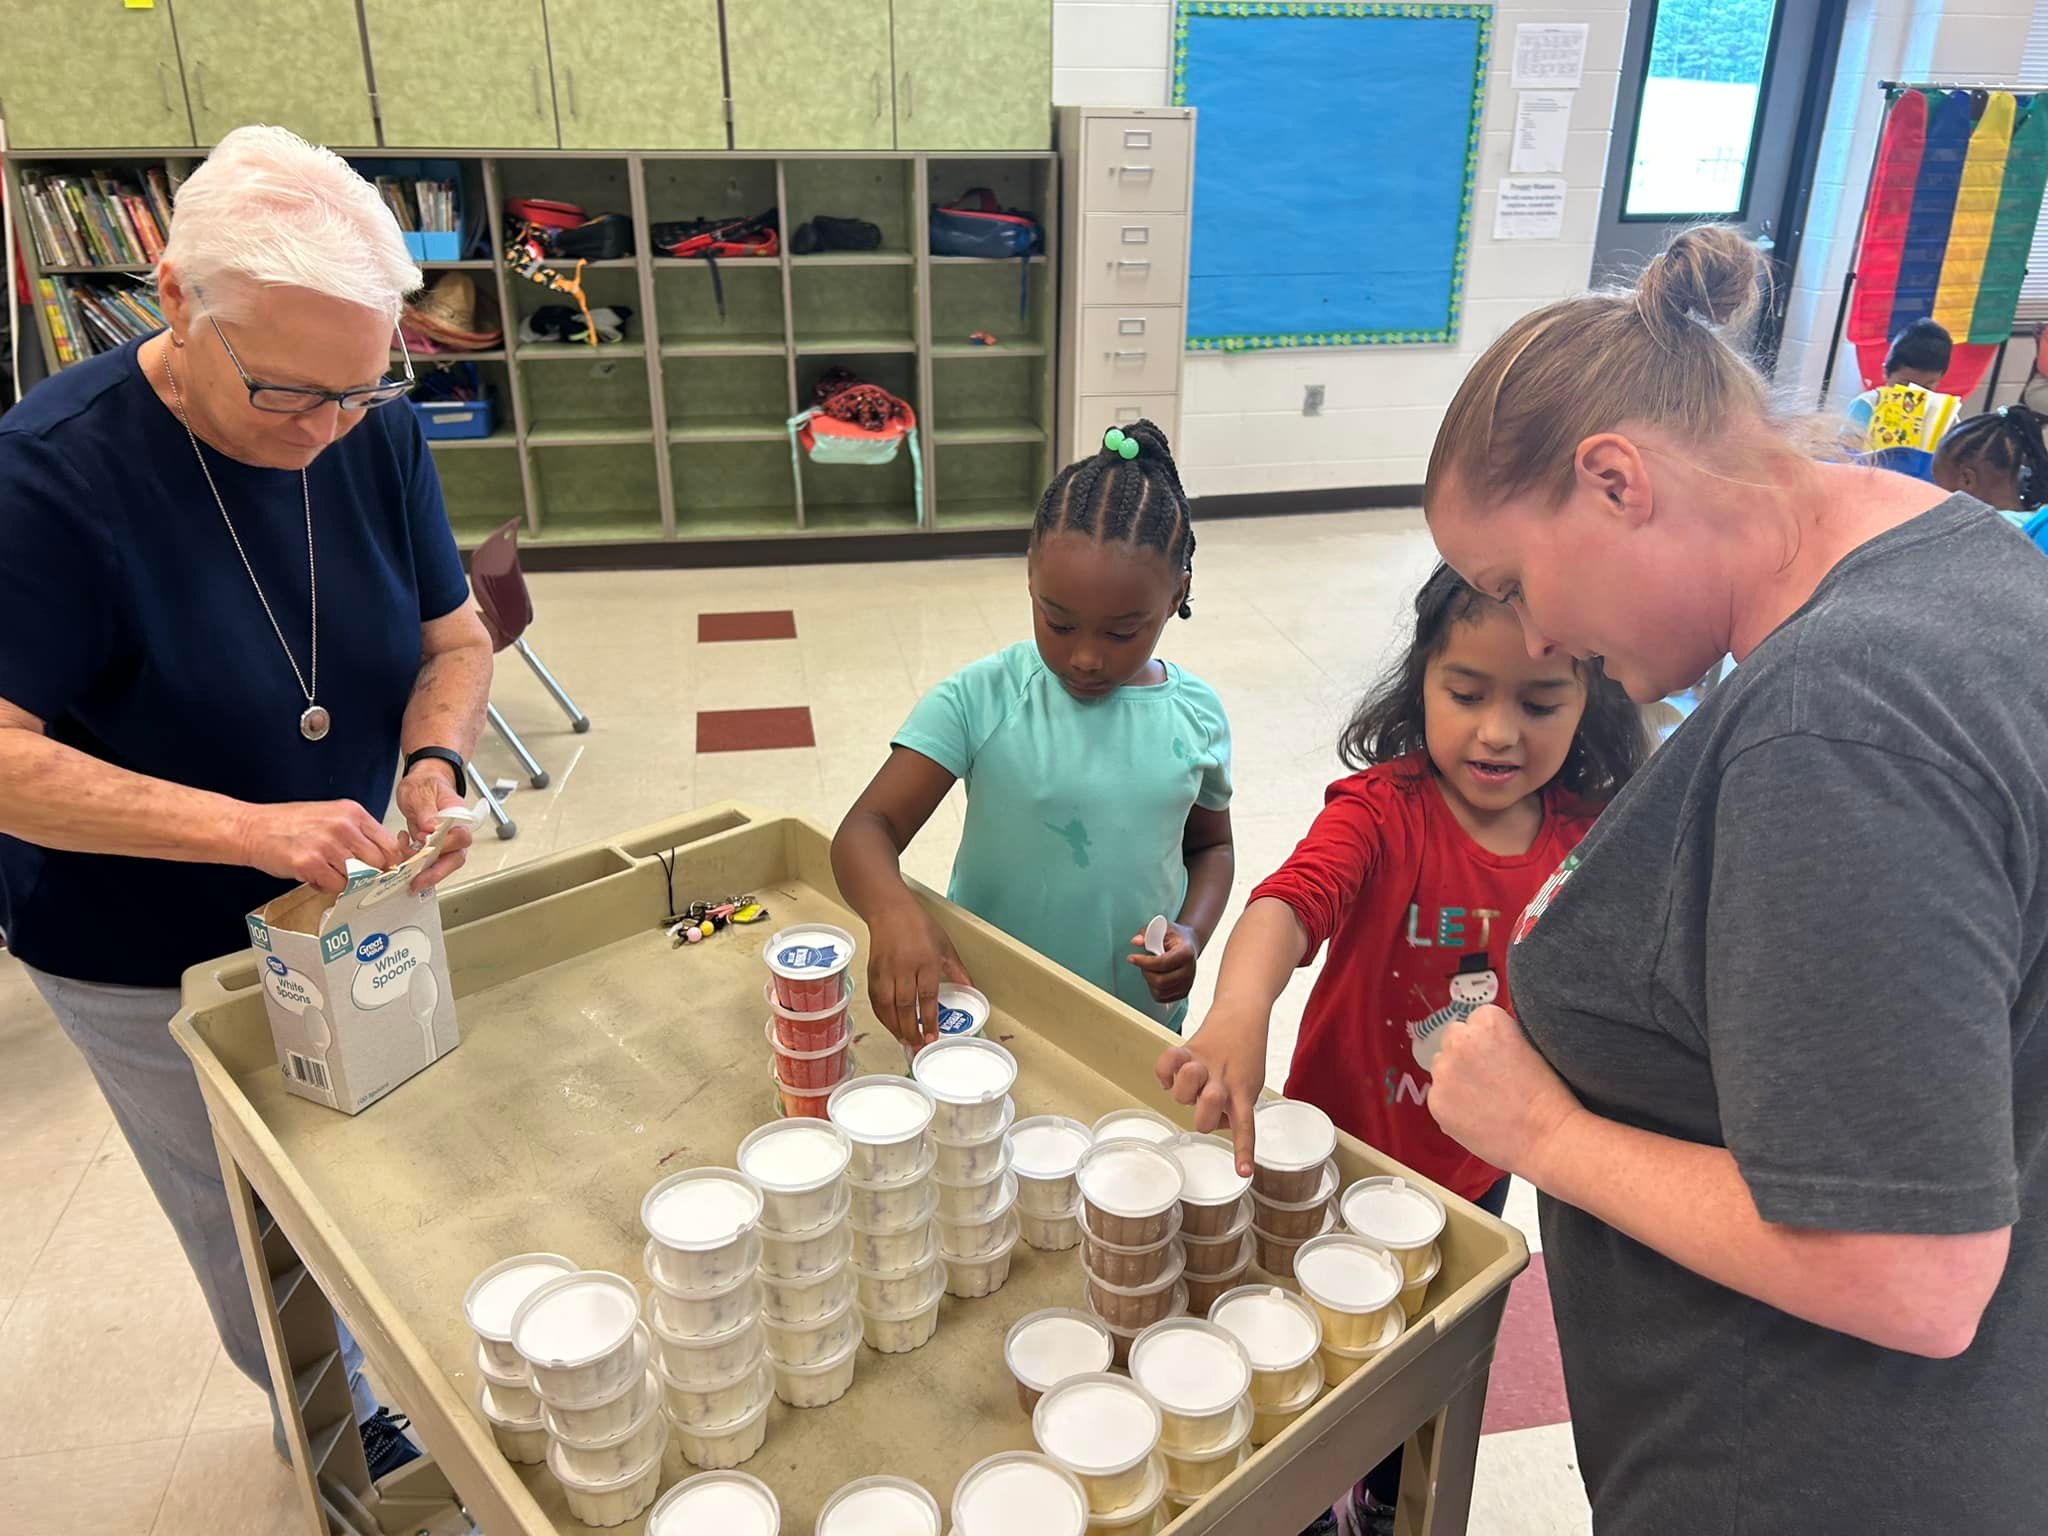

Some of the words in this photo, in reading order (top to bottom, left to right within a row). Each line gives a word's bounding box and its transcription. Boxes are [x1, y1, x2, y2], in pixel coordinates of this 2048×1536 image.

[250, 924, 268, 942] 100
[1407, 903, 1501, 949] LET
[325, 931, 349, 953] 100
[359, 936, 384, 955] Great
[375, 948, 409, 973] White
[372, 956, 417, 989] Spoons
[276, 985, 312, 1005] Spoons
[277, 977, 305, 994] White
